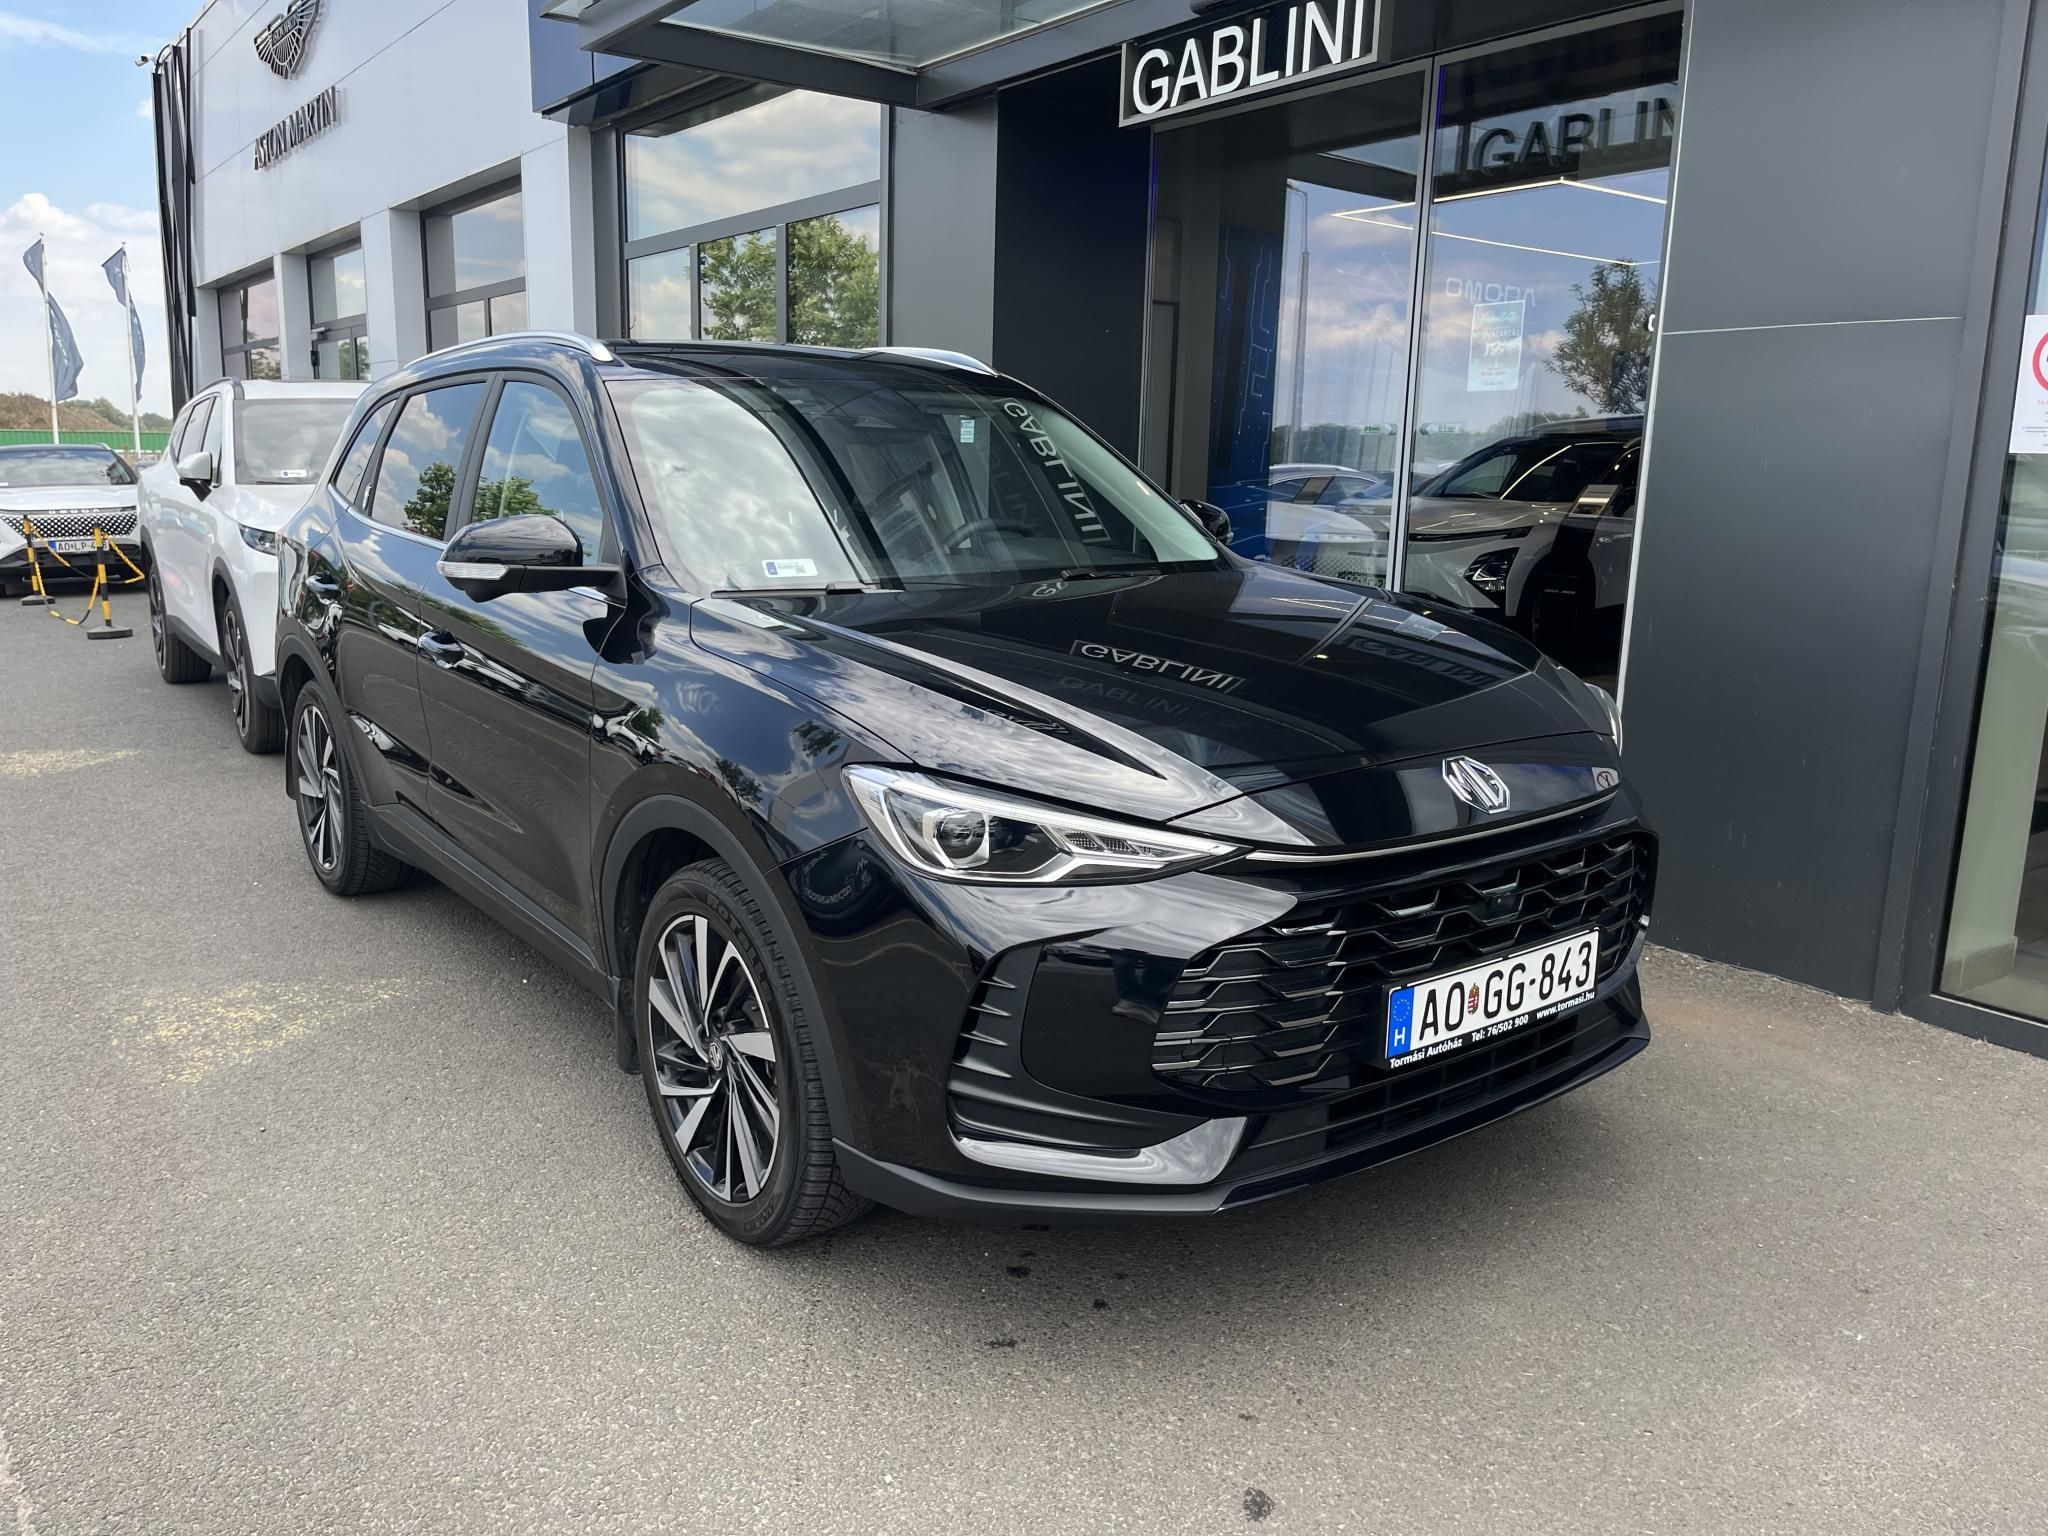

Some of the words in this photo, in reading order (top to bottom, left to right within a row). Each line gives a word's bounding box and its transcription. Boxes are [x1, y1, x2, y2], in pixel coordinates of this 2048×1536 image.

[1133, 0, 1364, 114] GABLINI
[254, 119, 287, 170] ASTON
[289, 85, 337, 148] MARTIN
[1445, 757, 1508, 811] MG
[1389, 1048, 1426, 1069] Tormási
[1426, 1037, 1463, 1058] Autóház
[1471, 1031, 1486, 1042] Tel:
[1487, 1020, 1513, 1037] 76/502
[1514, 1014, 1529, 1028] 900
[1536, 991, 1595, 1020] www.tormasi.hu
[1393, 1026, 1406, 1047] H
